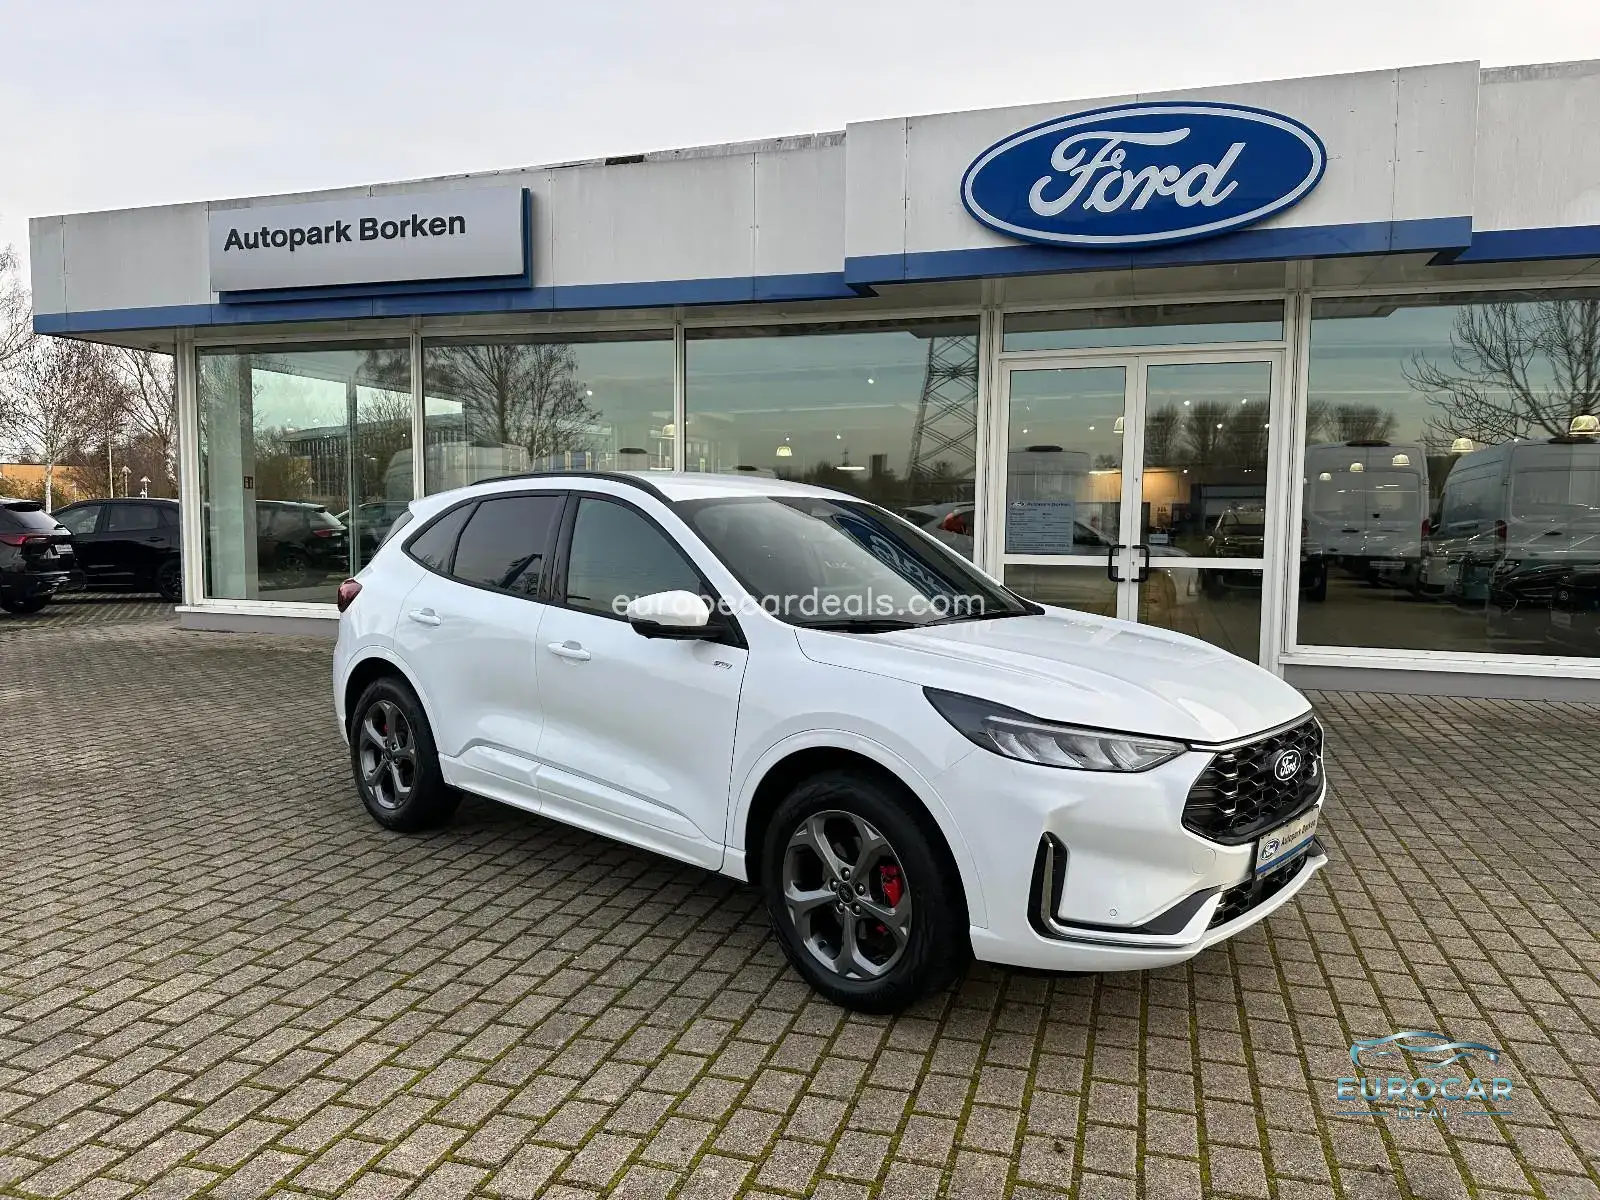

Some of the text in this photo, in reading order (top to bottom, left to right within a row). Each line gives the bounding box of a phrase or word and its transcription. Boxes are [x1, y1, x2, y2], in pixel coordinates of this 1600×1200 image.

[1029, 127, 1246, 216] Ford
[223, 213, 466, 252] Autopark Borken
[1280, 754, 1297, 777] Ford
